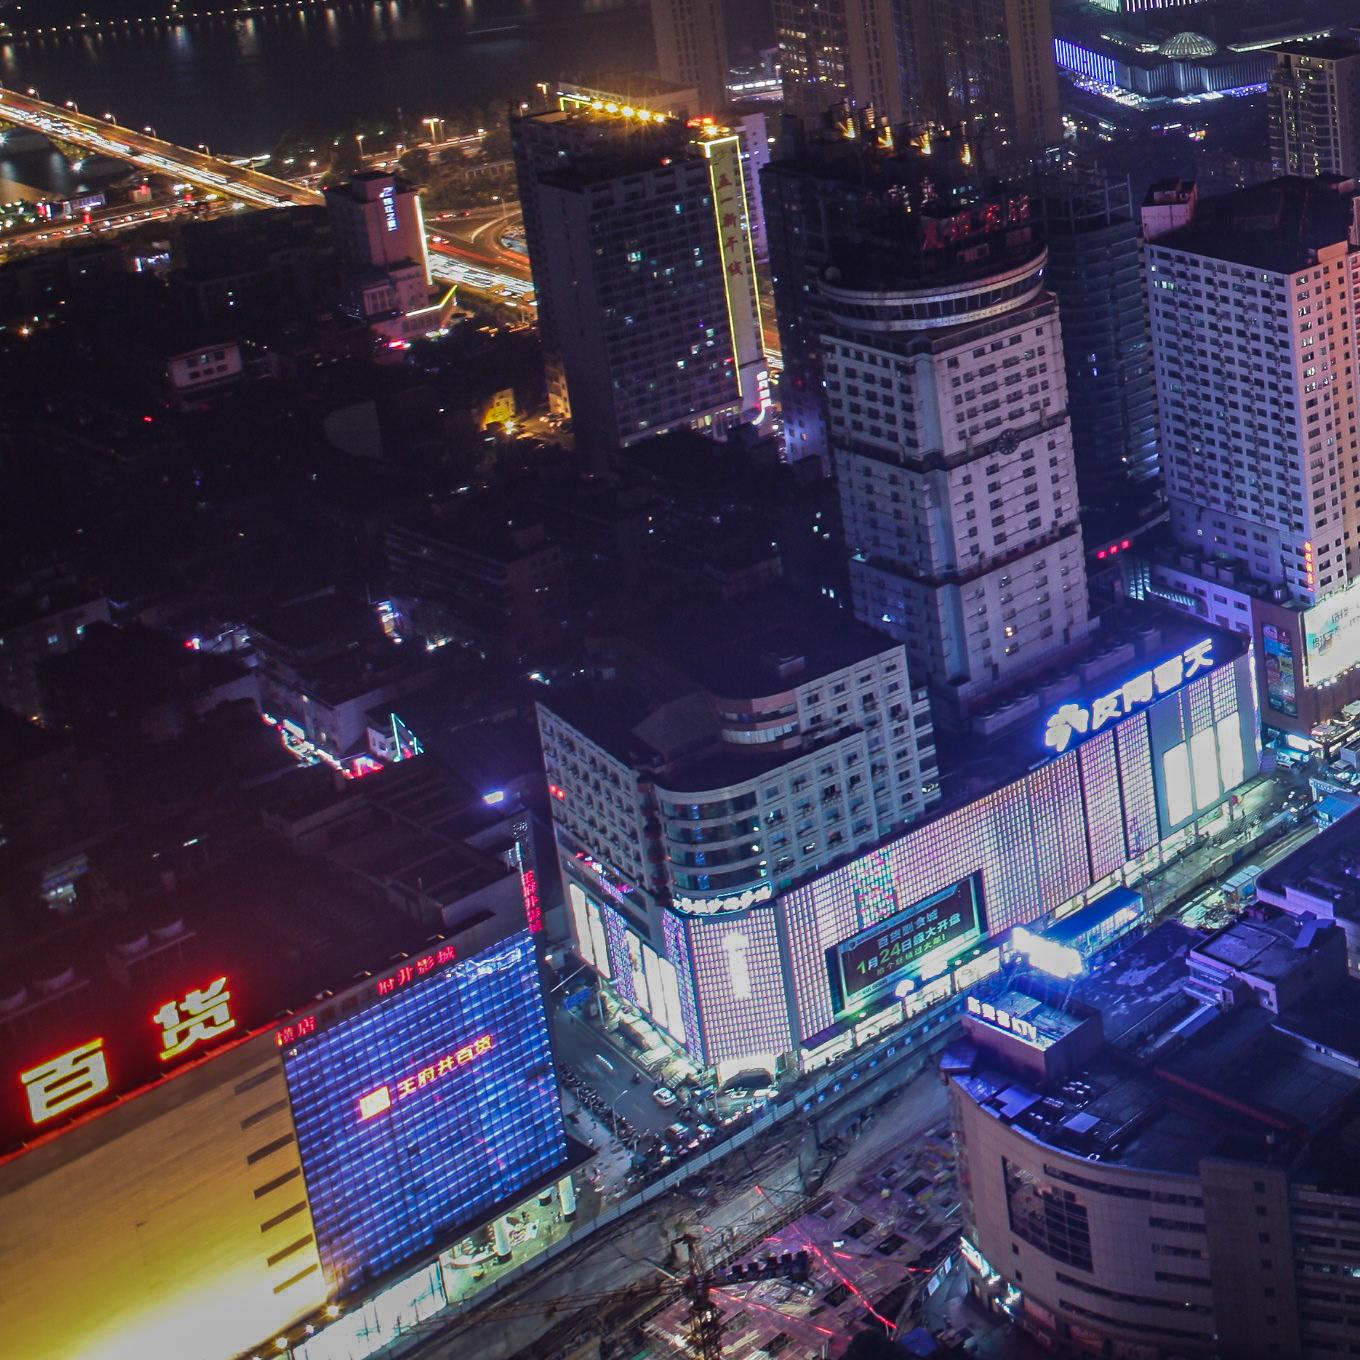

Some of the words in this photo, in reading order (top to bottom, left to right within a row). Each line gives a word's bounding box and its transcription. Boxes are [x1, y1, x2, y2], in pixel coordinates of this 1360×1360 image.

[717, 173, 743, 276] 五一新干线
[21, 976, 236, 1124] 百货
[397, 1034, 494, 1099] 王府井百货
